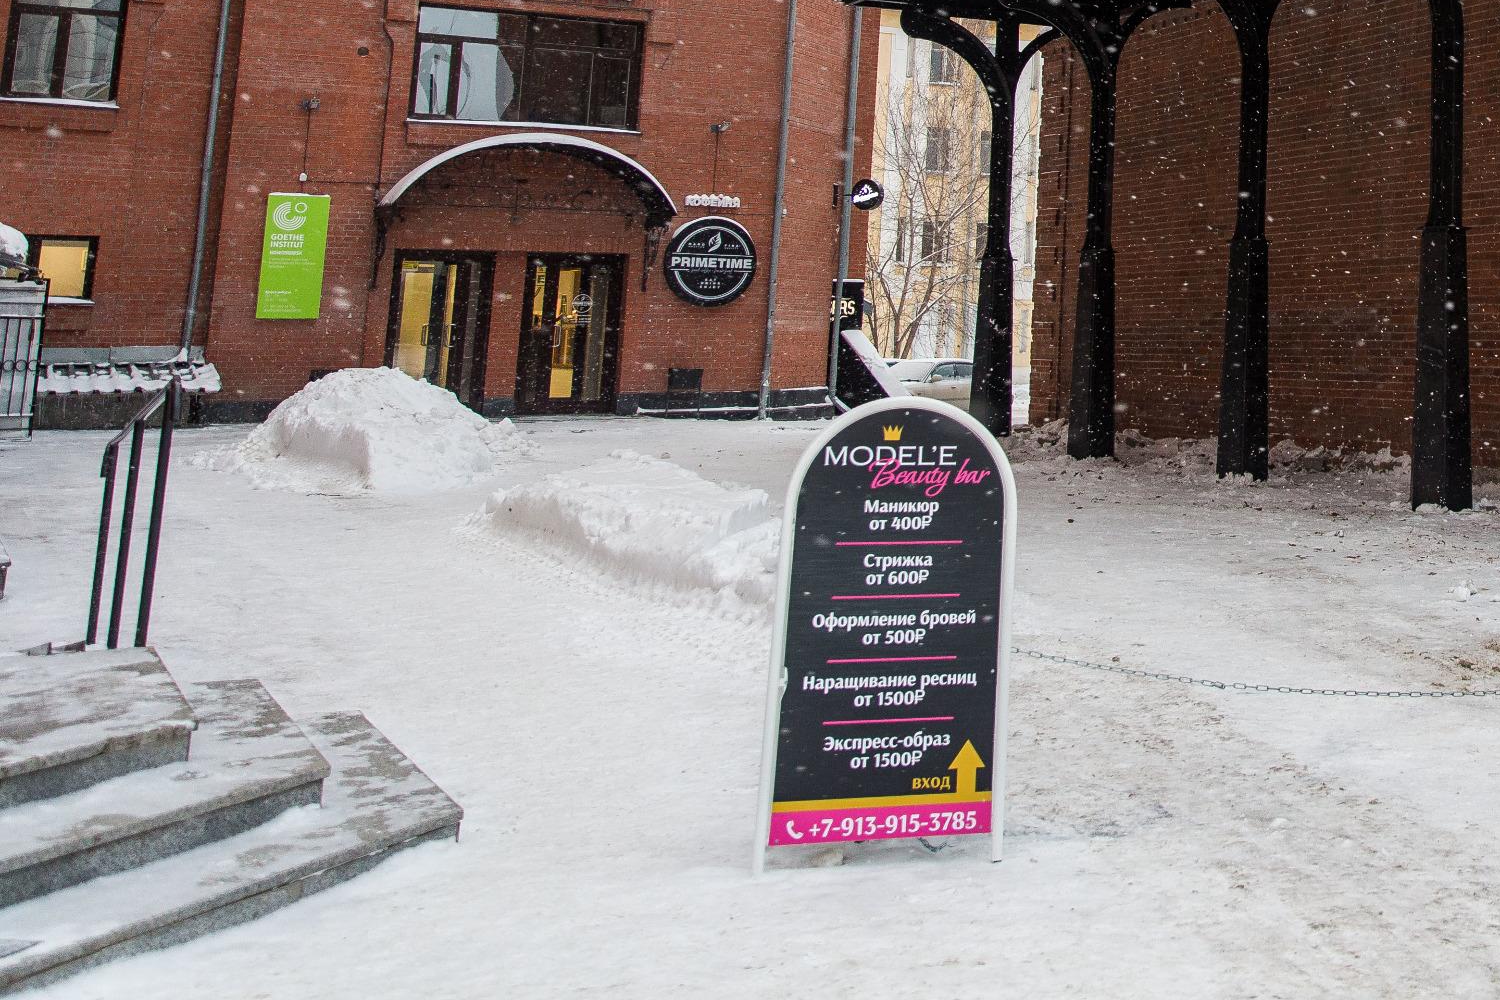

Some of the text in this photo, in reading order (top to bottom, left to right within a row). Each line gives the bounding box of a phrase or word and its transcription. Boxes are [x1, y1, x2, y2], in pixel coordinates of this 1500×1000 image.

[270, 233, 305, 241] GOETHE
[671, 256, 753, 269] PRIMETIME
[868, 458, 991, 497] Beauty bar
[863, 499, 940, 516] Маникюр
[869, 518, 887, 530] от
[863, 553, 933, 572] Стрижка
[865, 573, 884, 585] от
[812, 609, 977, 632] Оформление бровей
[862, 633, 882, 645] от
[802, 672, 978, 694] Наращивание ресниц
[853, 695, 873, 707] от
[822, 731, 951, 751] Экспресс-образ
[850, 756, 870, 769] от
[809, 811, 977, 838] +7-913-915-3785
